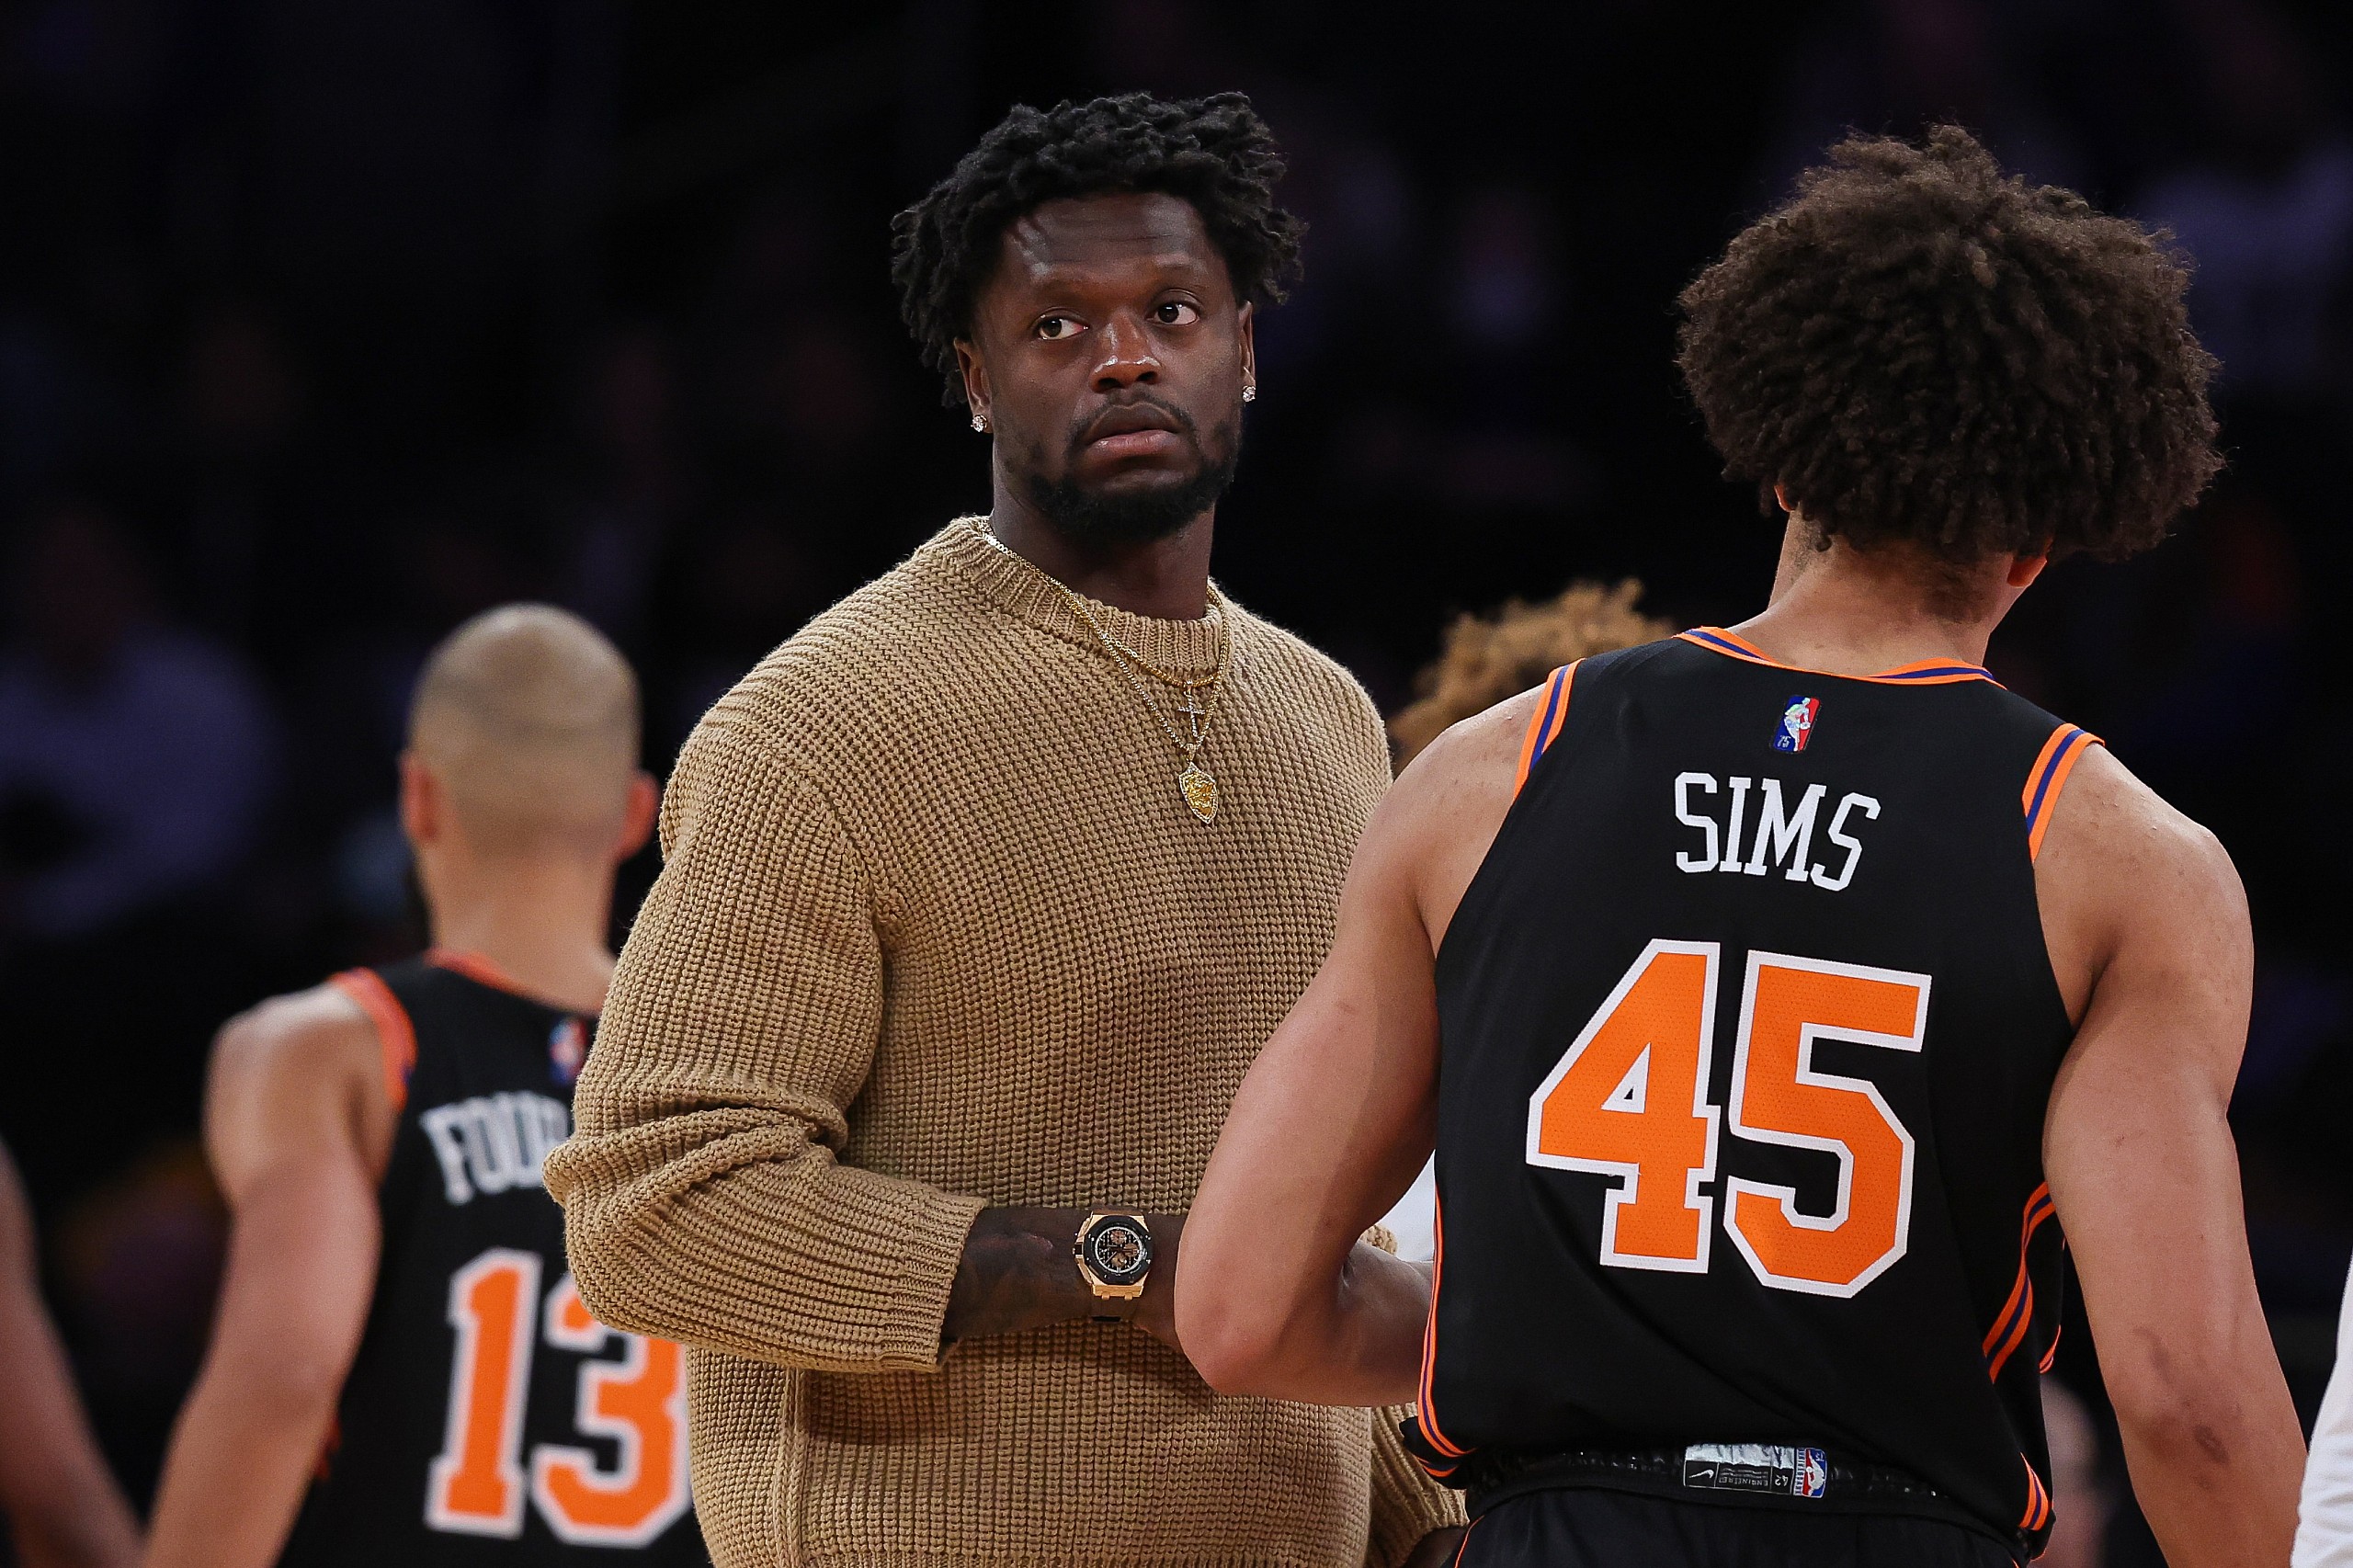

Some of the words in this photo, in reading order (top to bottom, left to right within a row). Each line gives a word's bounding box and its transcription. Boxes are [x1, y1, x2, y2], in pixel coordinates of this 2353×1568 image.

[1674, 772, 1881, 892] SIMS
[1778, 735, 1791, 748] 75
[1526, 938, 1932, 1299] 45
[423, 1248, 693, 1548] 13
